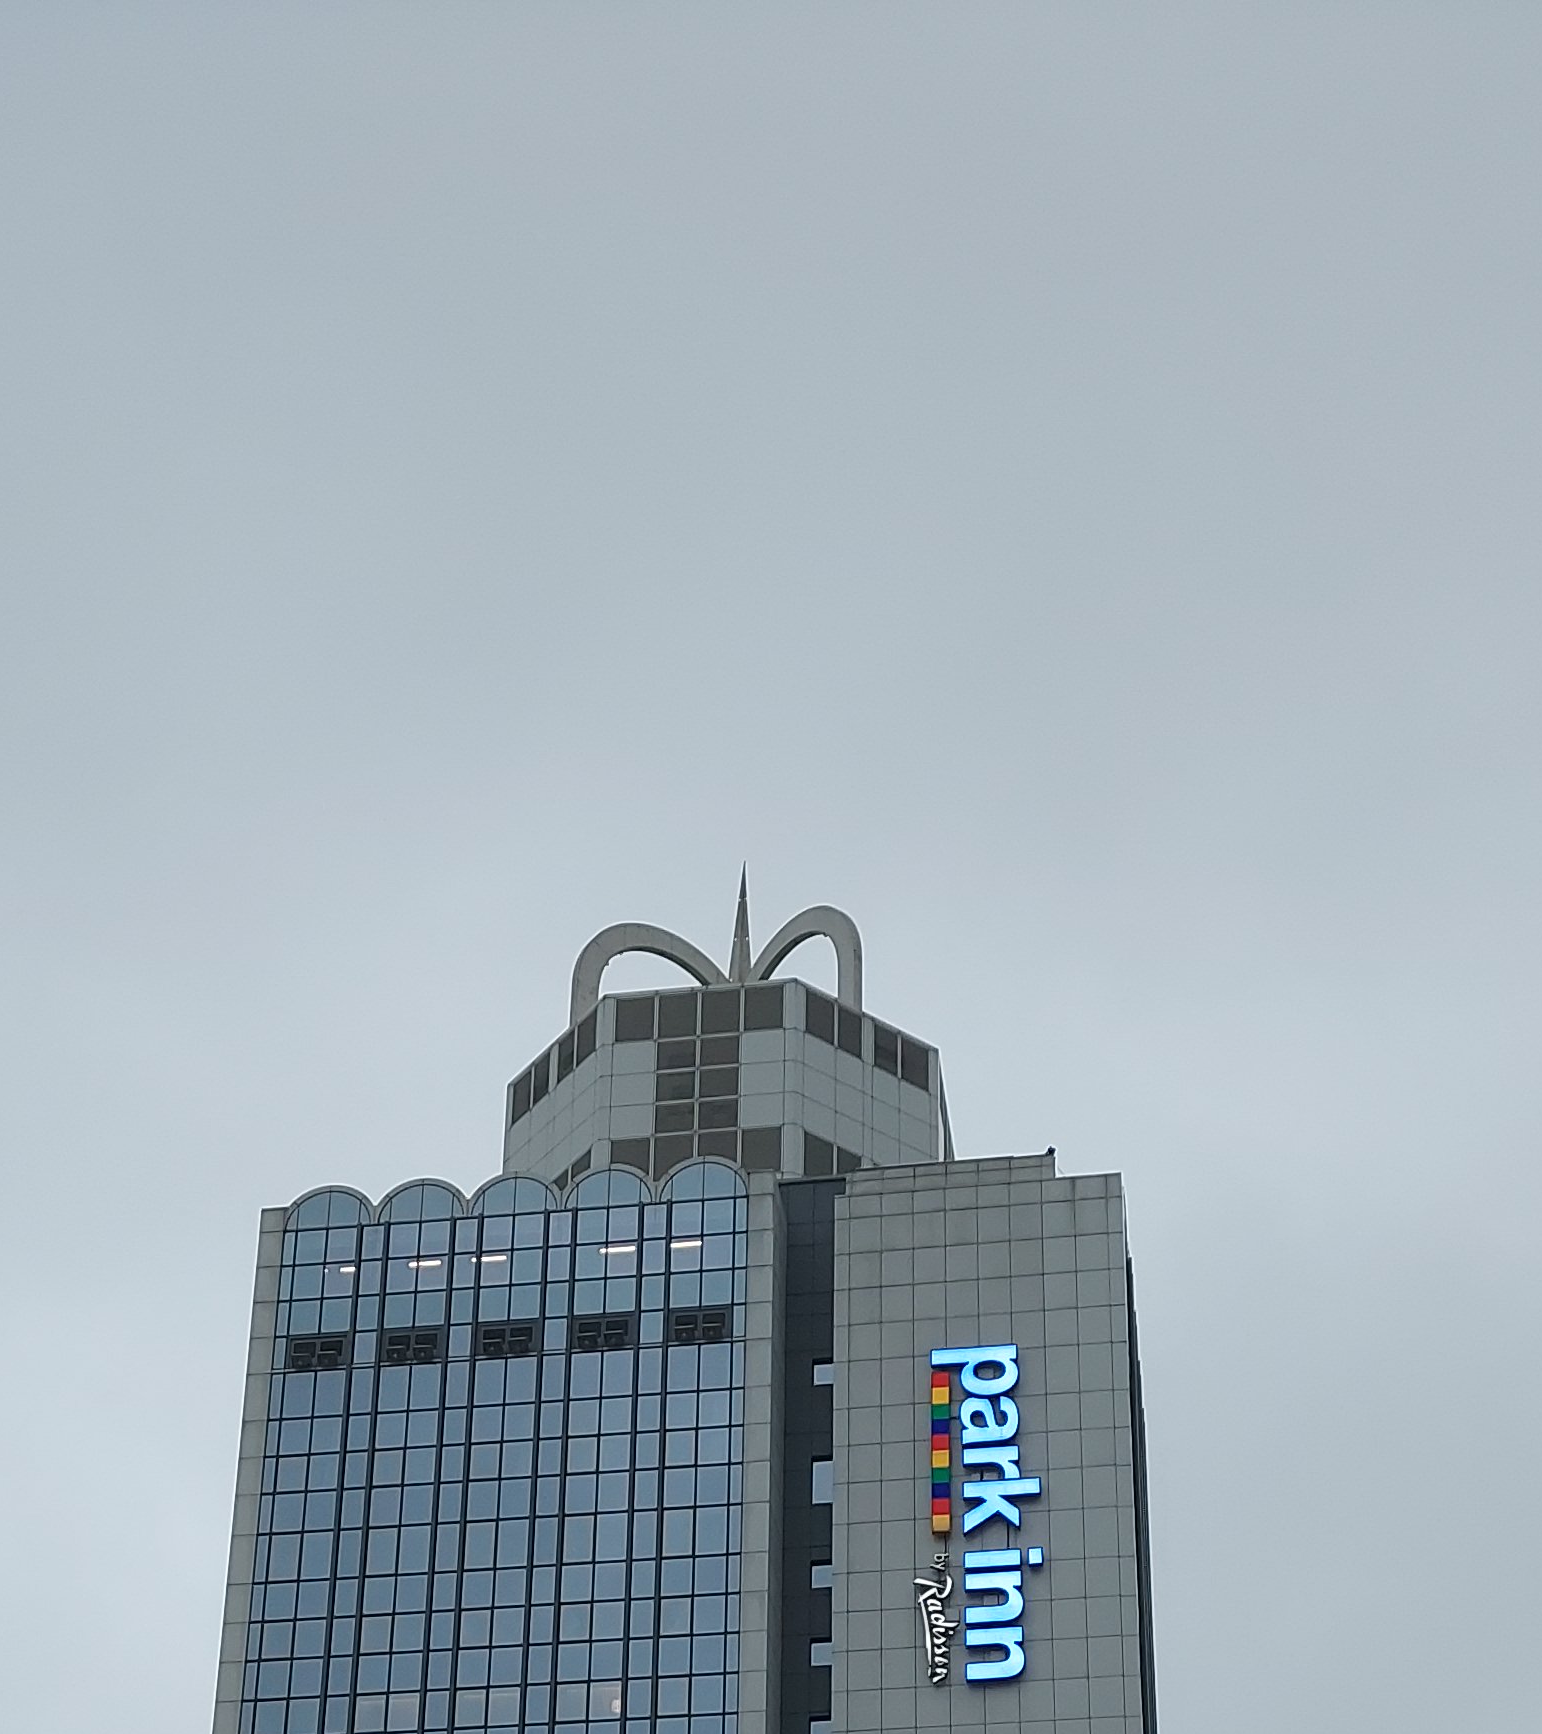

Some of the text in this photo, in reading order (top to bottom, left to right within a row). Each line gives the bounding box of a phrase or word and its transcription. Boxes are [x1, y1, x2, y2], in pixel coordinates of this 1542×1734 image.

[913, 1552, 960, 1684] by Radisson
[930, 1343, 1044, 1683] park inn
